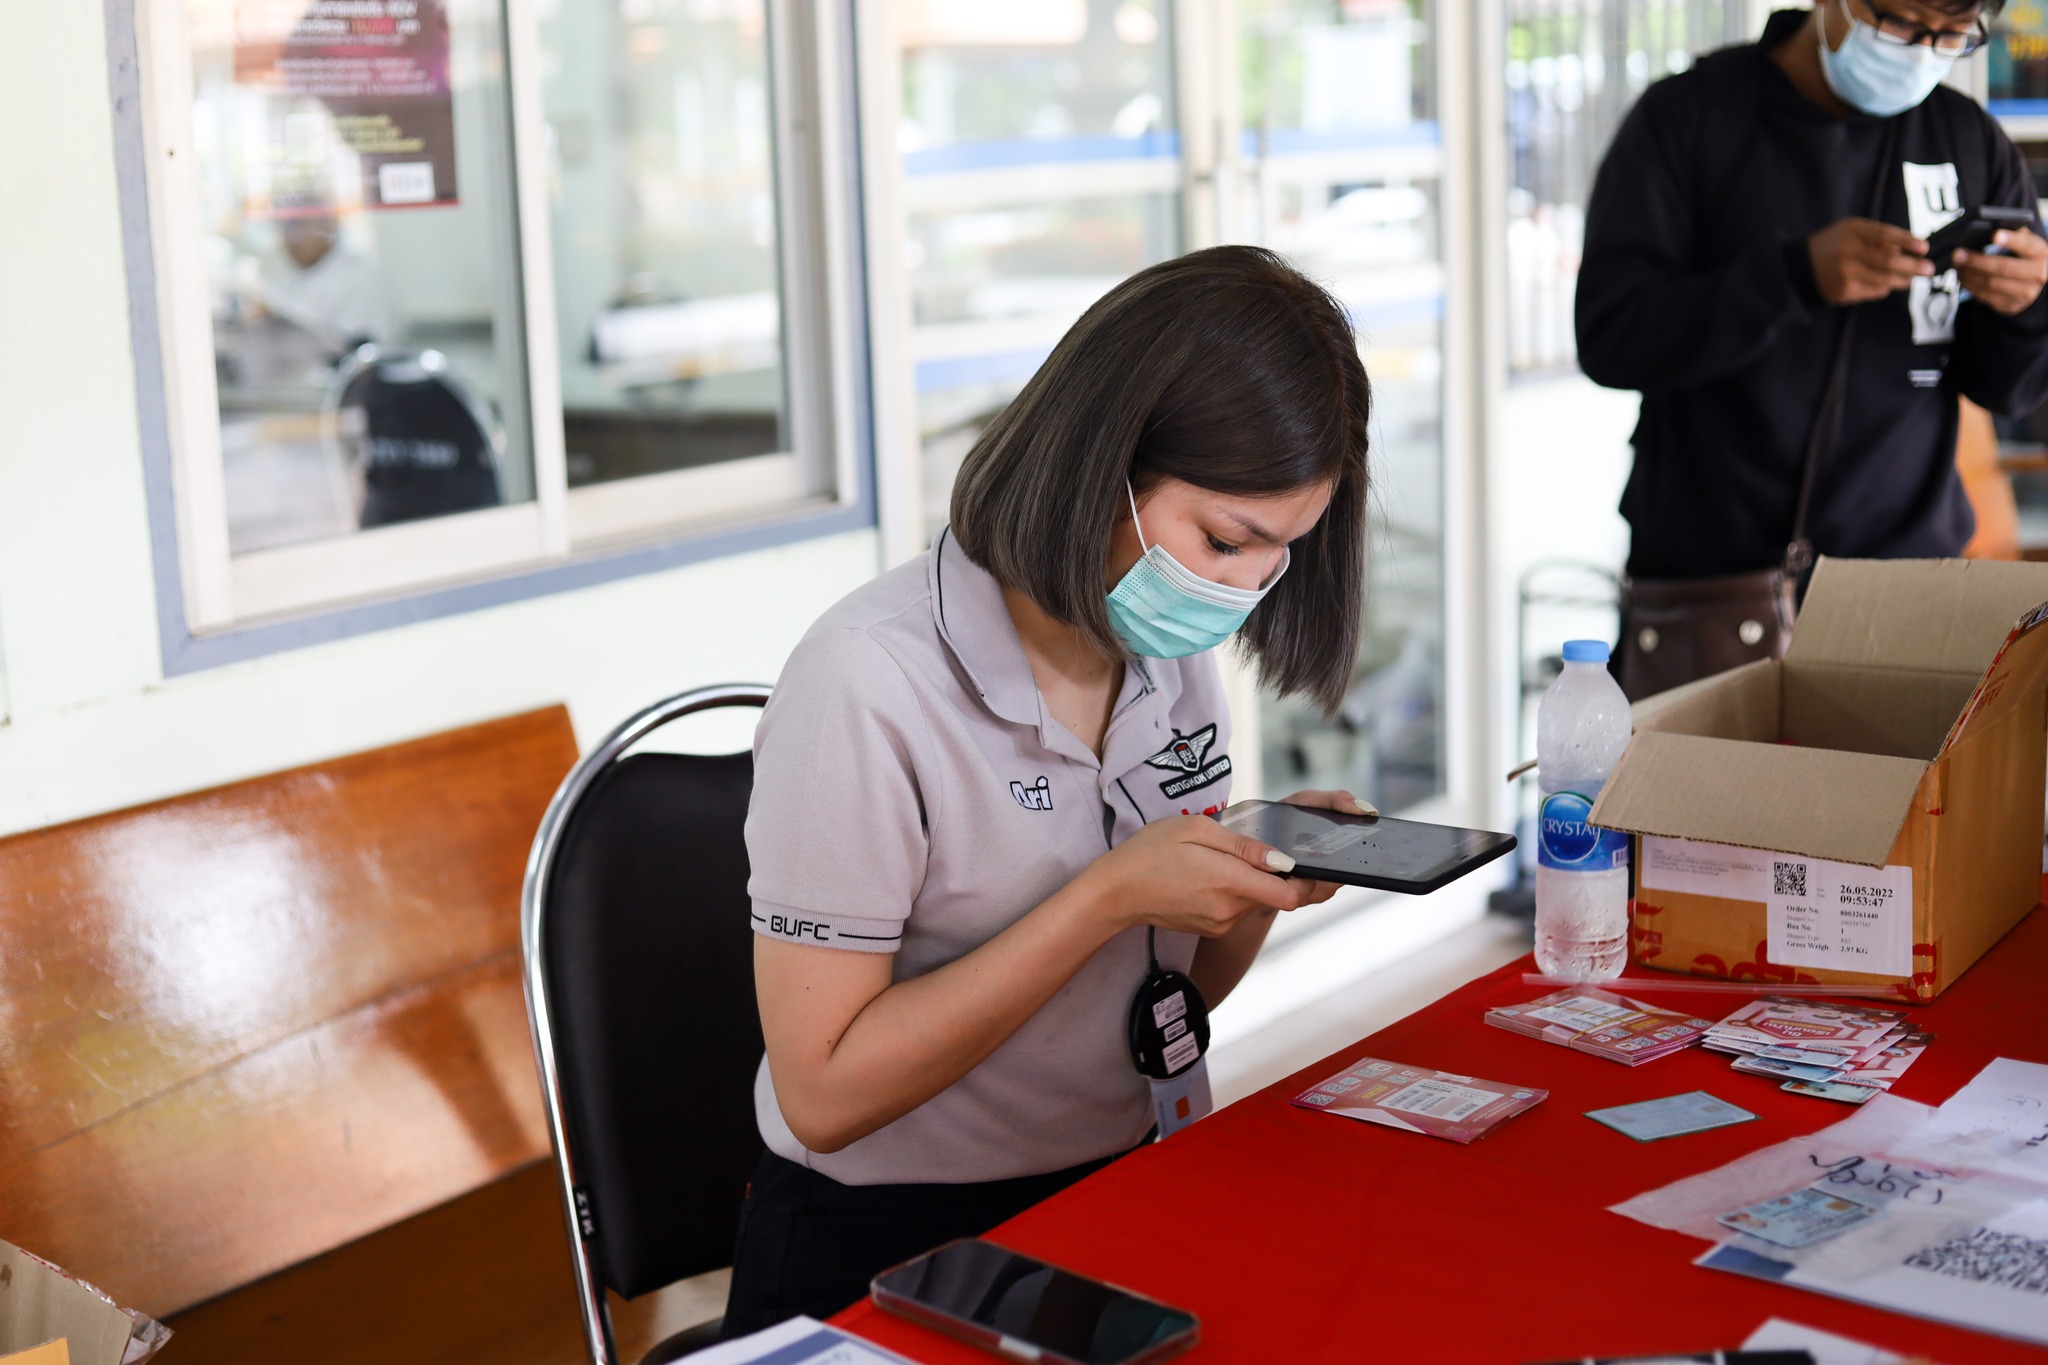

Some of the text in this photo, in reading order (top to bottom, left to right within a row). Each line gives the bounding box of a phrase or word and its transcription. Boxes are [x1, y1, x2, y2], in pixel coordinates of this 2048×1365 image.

[1165, 758, 1230, 796] BANGKOK UNITED
[1840, 884, 1893, 898] 26.05.2022
[1840, 895, 1883, 907] 09:53:47
[1786, 905, 1820, 914] Order No.
[770, 914, 830, 941] BUFC
[1786, 940, 1806, 948] Gross
